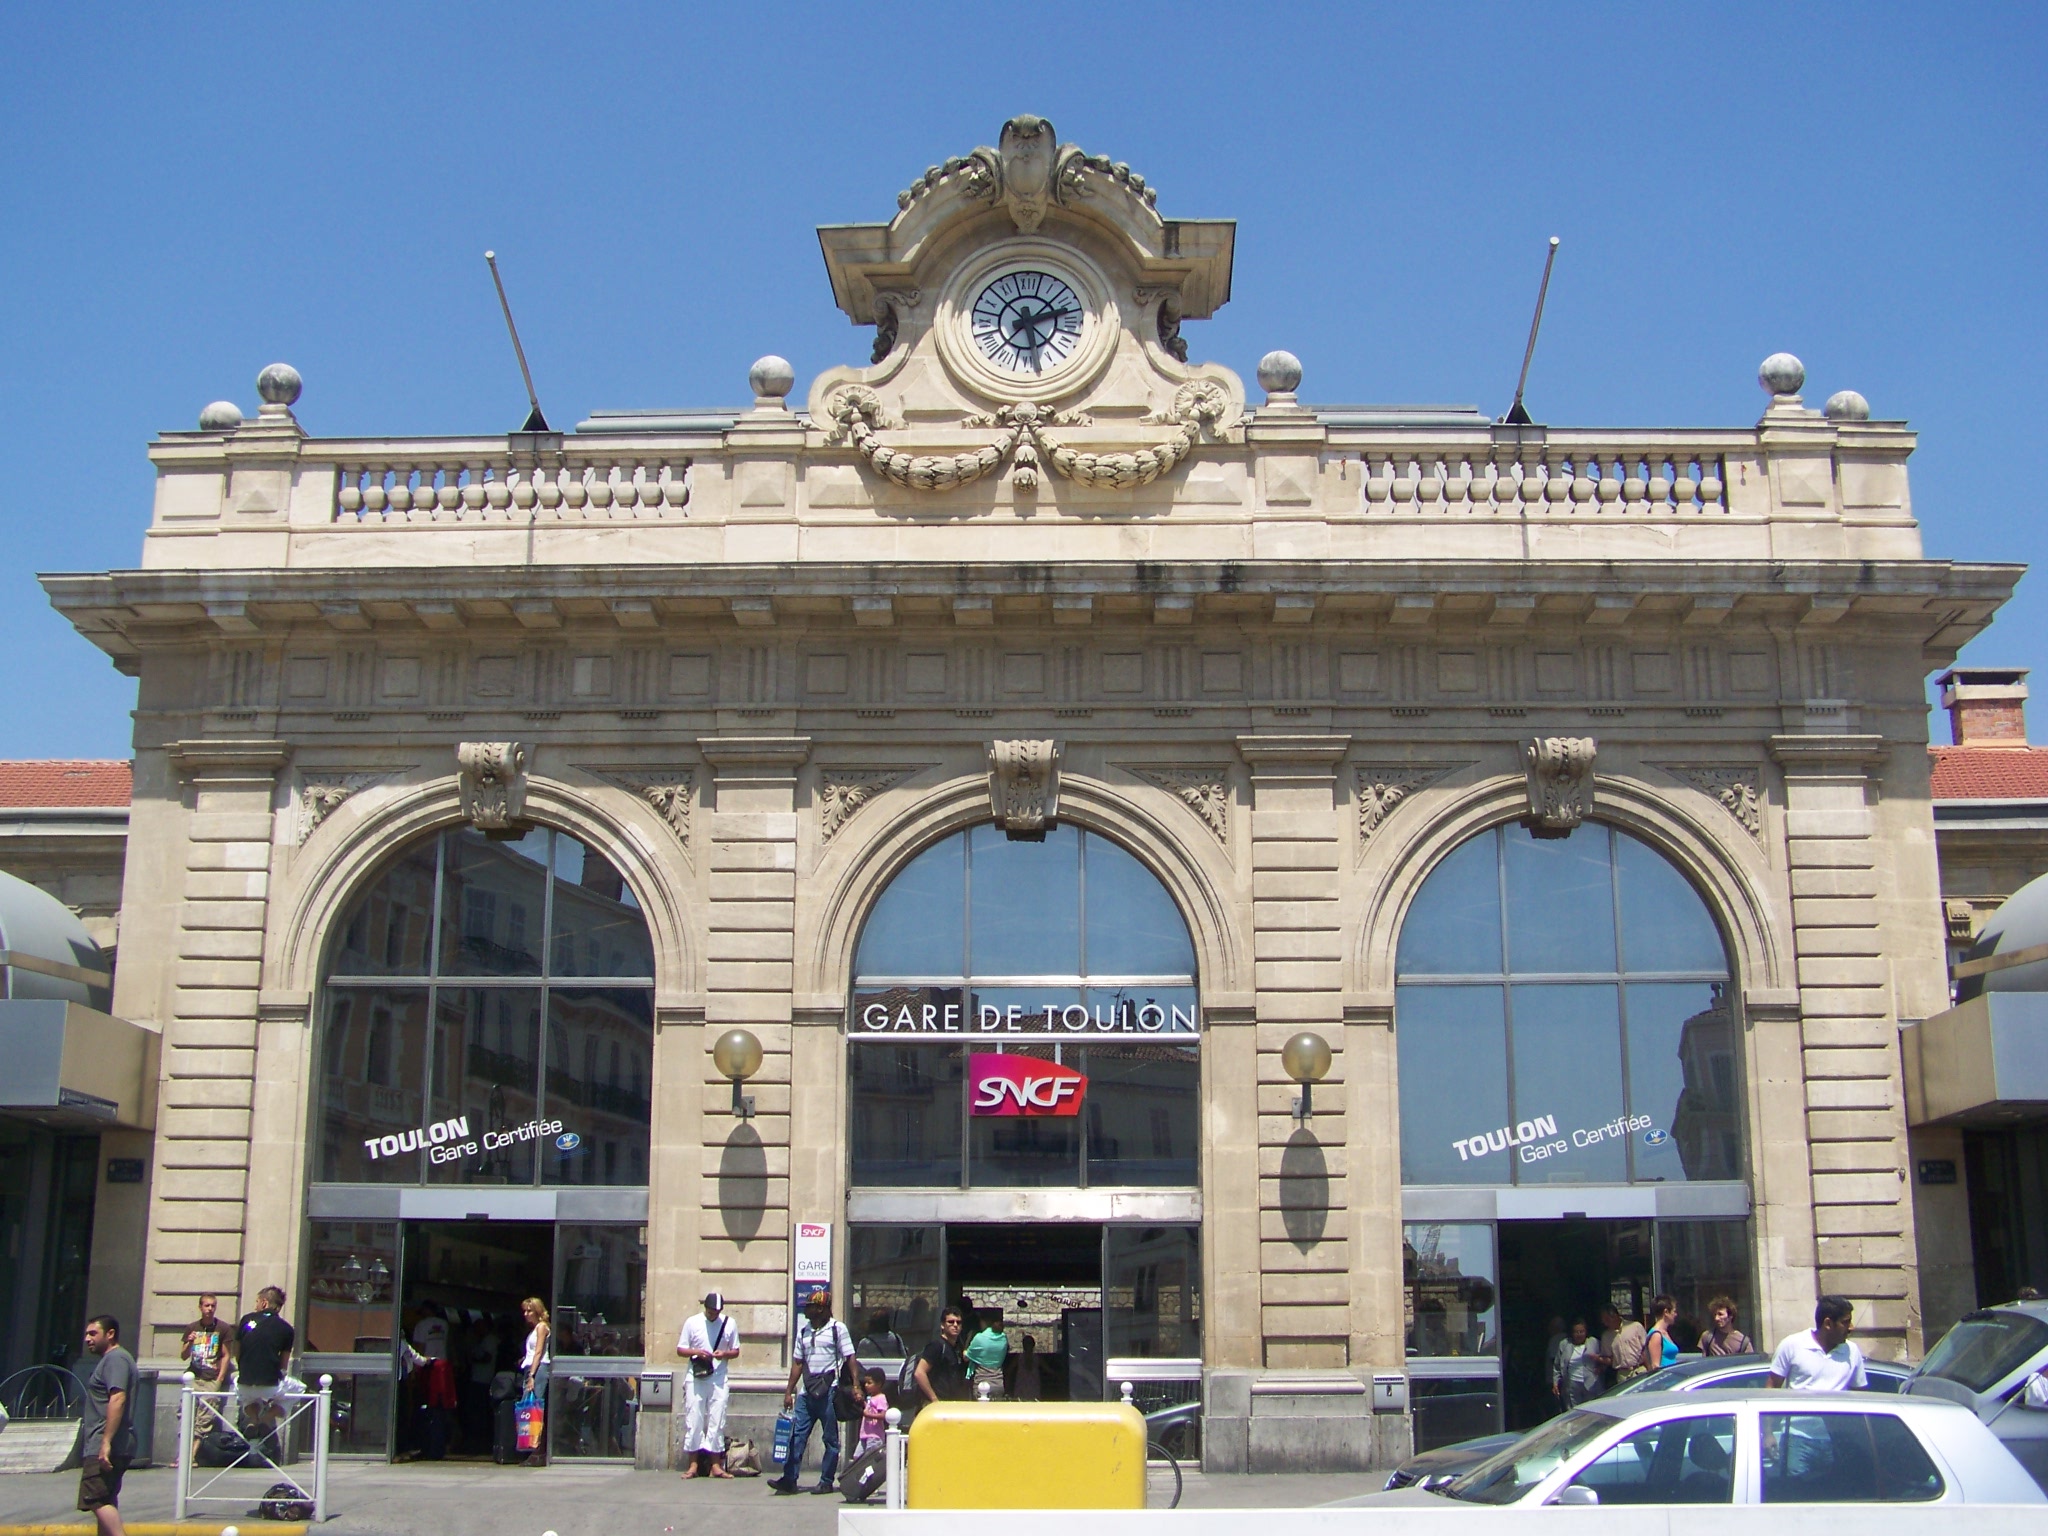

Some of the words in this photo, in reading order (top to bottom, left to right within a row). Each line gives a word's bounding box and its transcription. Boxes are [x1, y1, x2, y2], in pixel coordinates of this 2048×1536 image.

[1000, 282, 1013, 296] XI
[1020, 278, 1036, 290] XII
[985, 299, 998, 309] X
[863, 1004, 959, 1031] GARE
[981, 1004, 1022, 1031] DE
[1042, 1003, 1195, 1031] TOULON
[974, 1077, 1081, 1107] SNCF
[364, 1115, 470, 1160] TOULON
[430, 1141, 478, 1165] Gare
[483, 1118, 563, 1151] Certifiée
[562, 1134, 574, 1143] NF
[1452, 1114, 1558, 1161] TOULON
[1520, 1140, 1568, 1163] Gare
[1572, 1114, 1652, 1148] Certifiée
[1650, 1130, 1661, 1138] NF
[798, 1261, 827, 1271] GARE
